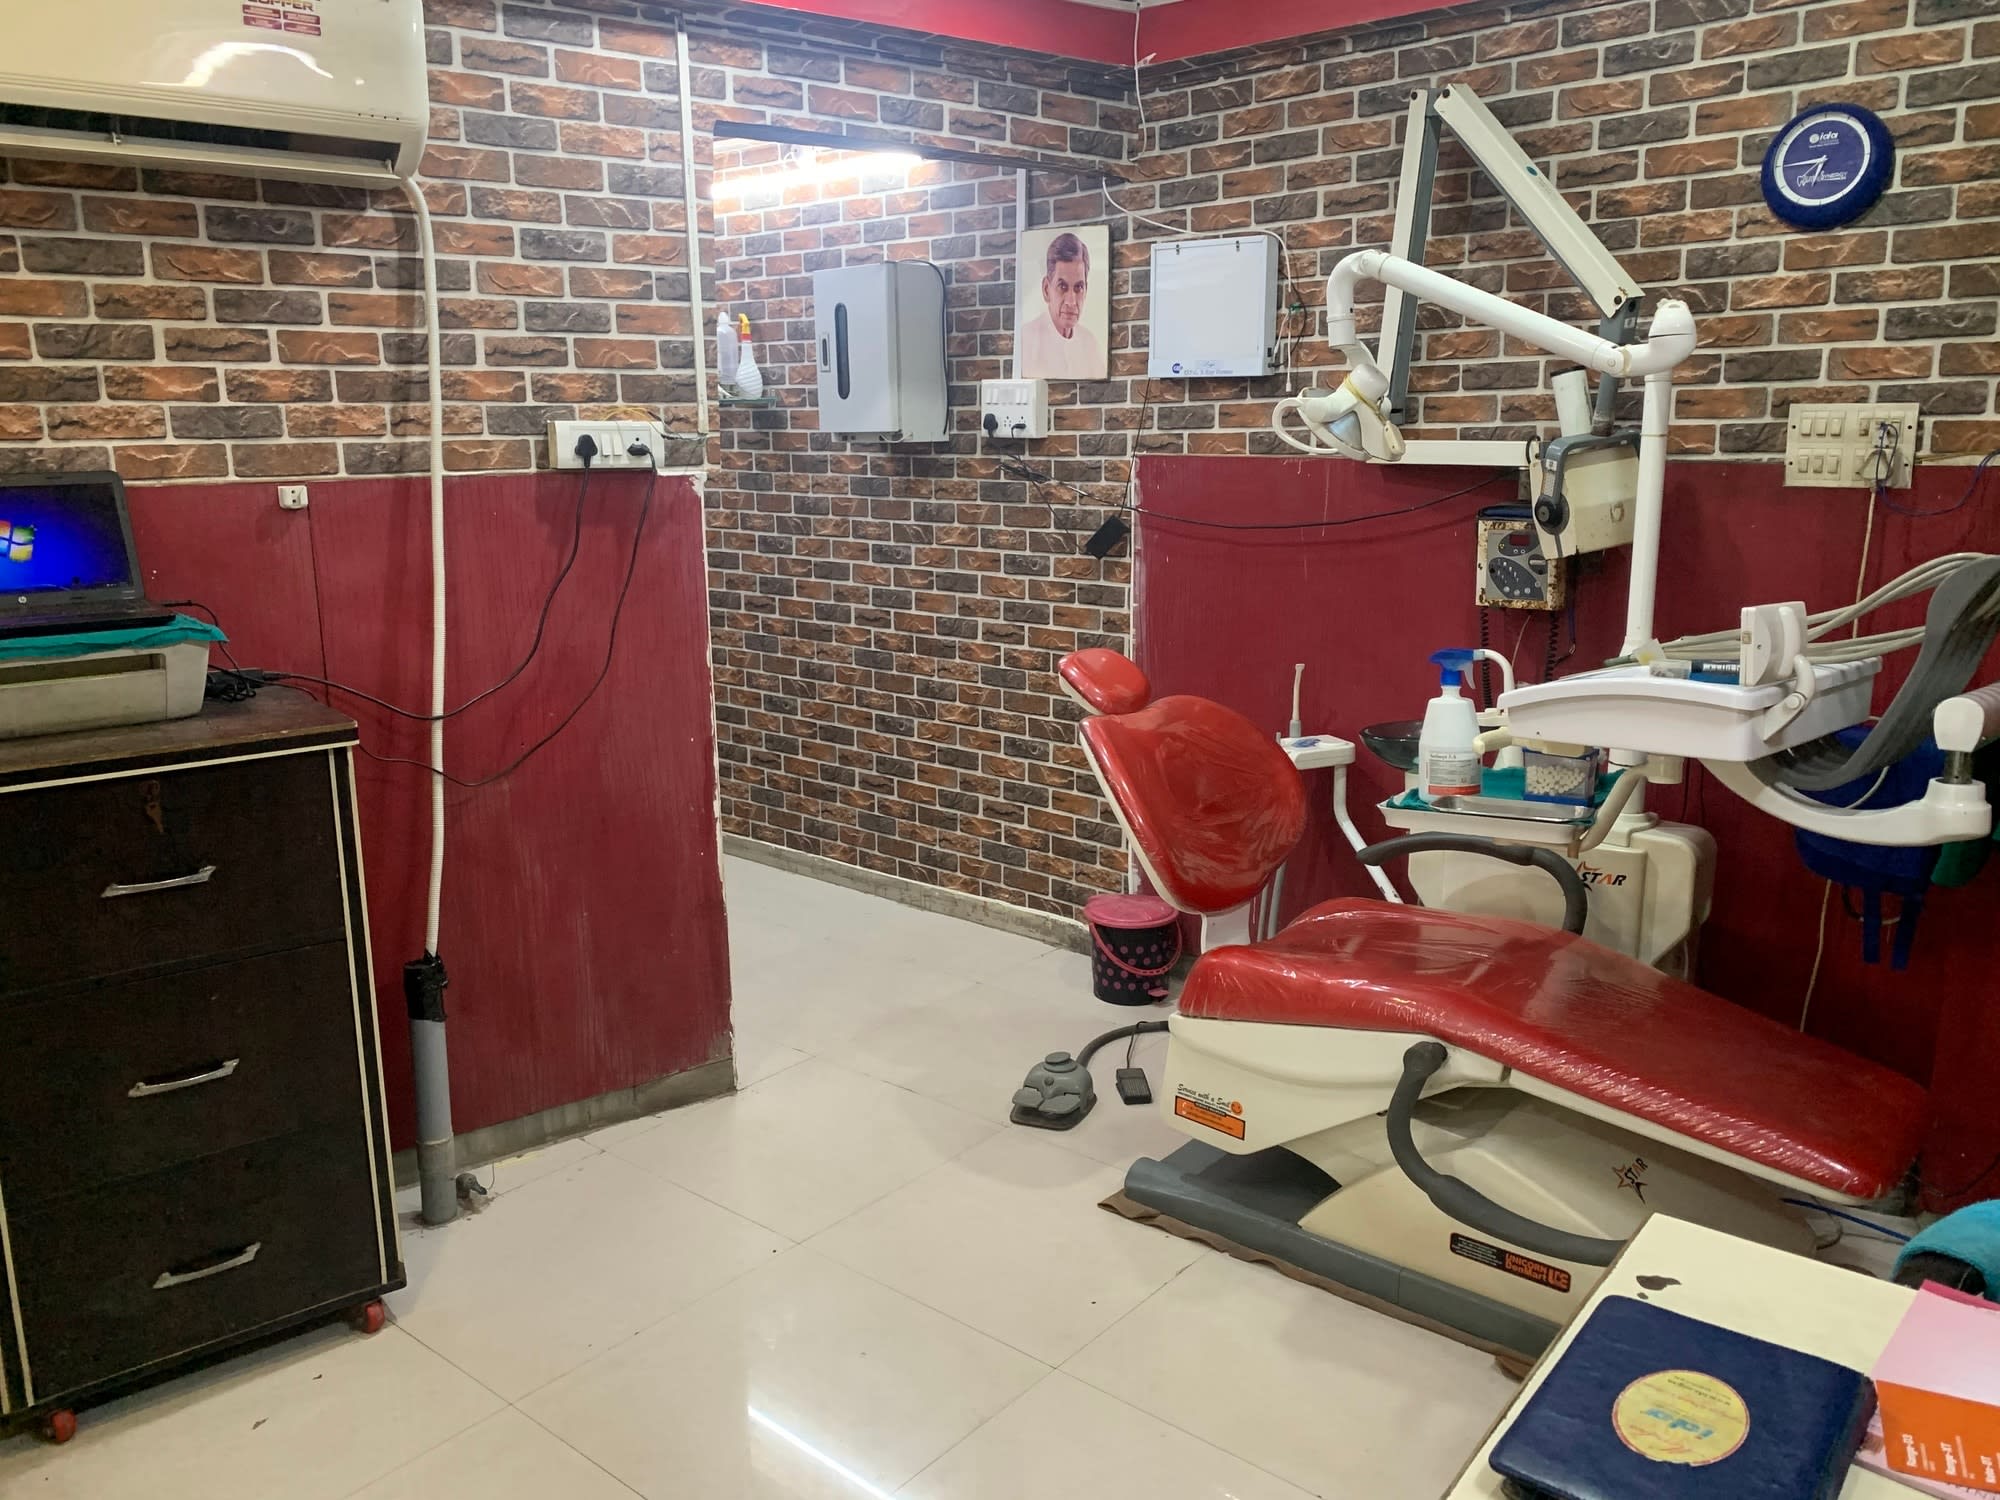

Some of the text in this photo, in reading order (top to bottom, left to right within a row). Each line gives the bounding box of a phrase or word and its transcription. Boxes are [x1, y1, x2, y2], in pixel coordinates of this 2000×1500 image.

[248, 0, 314, 11] PPER
[1582, 871, 1627, 886] STAR
[1624, 1157, 1649, 1185] STAR
[1505, 1252, 1548, 1274] UNICORN
